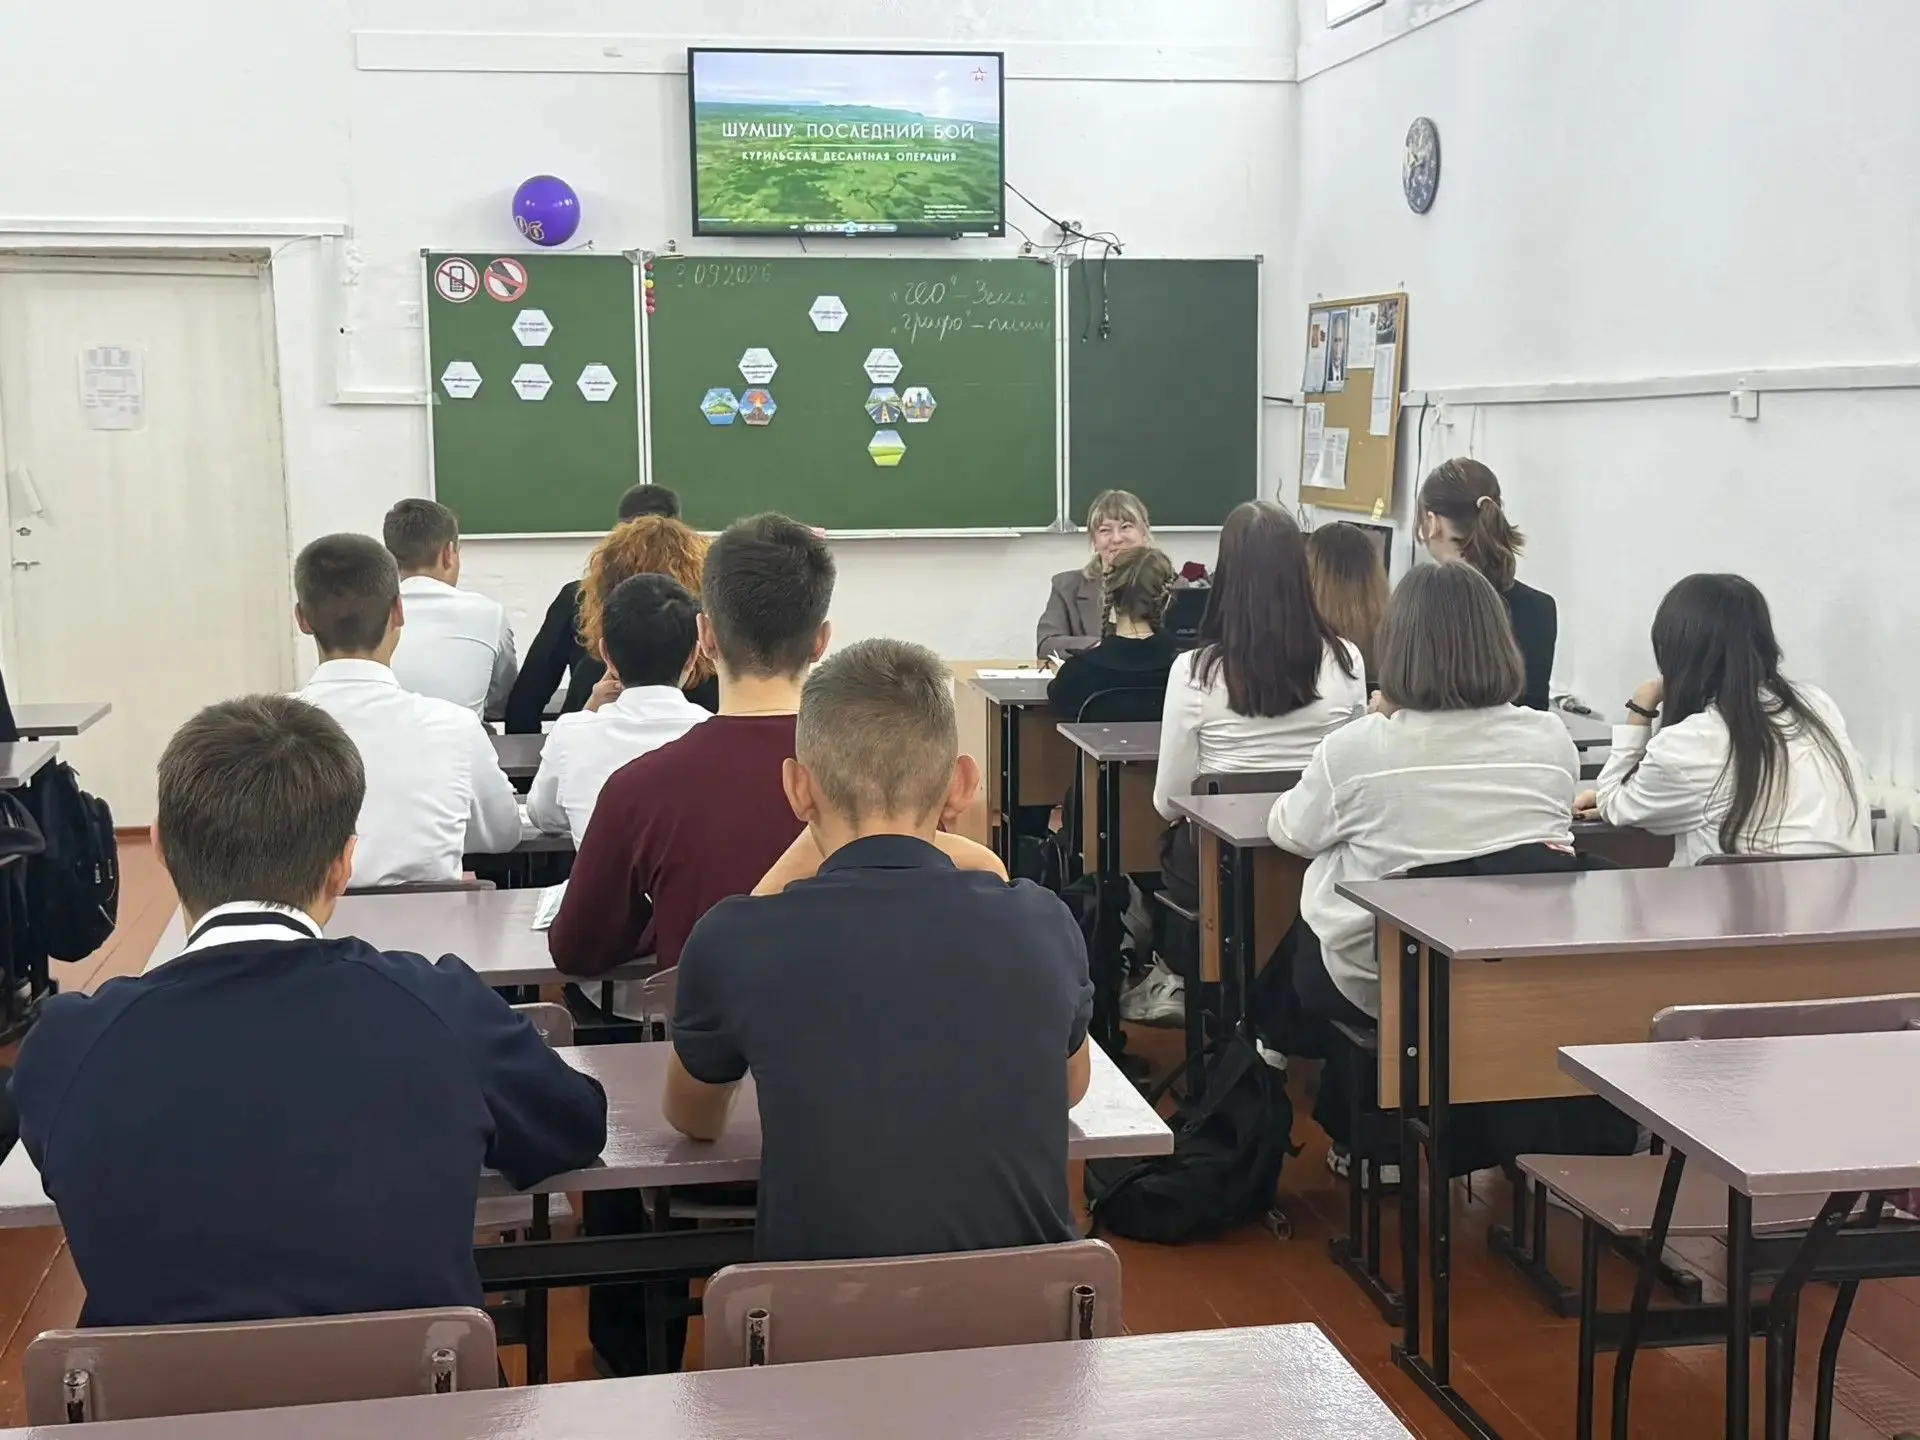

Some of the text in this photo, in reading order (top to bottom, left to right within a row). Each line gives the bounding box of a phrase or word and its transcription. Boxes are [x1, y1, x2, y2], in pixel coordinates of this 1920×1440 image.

[806, 122, 924, 140] ПОСЛЕДНИЙ
[933, 123, 974, 140] БОЙ
[741, 151, 957, 163] КУРИЛЬСКАЯ ДЕСАНТНАЯ ОПЕРАЦИЯ
